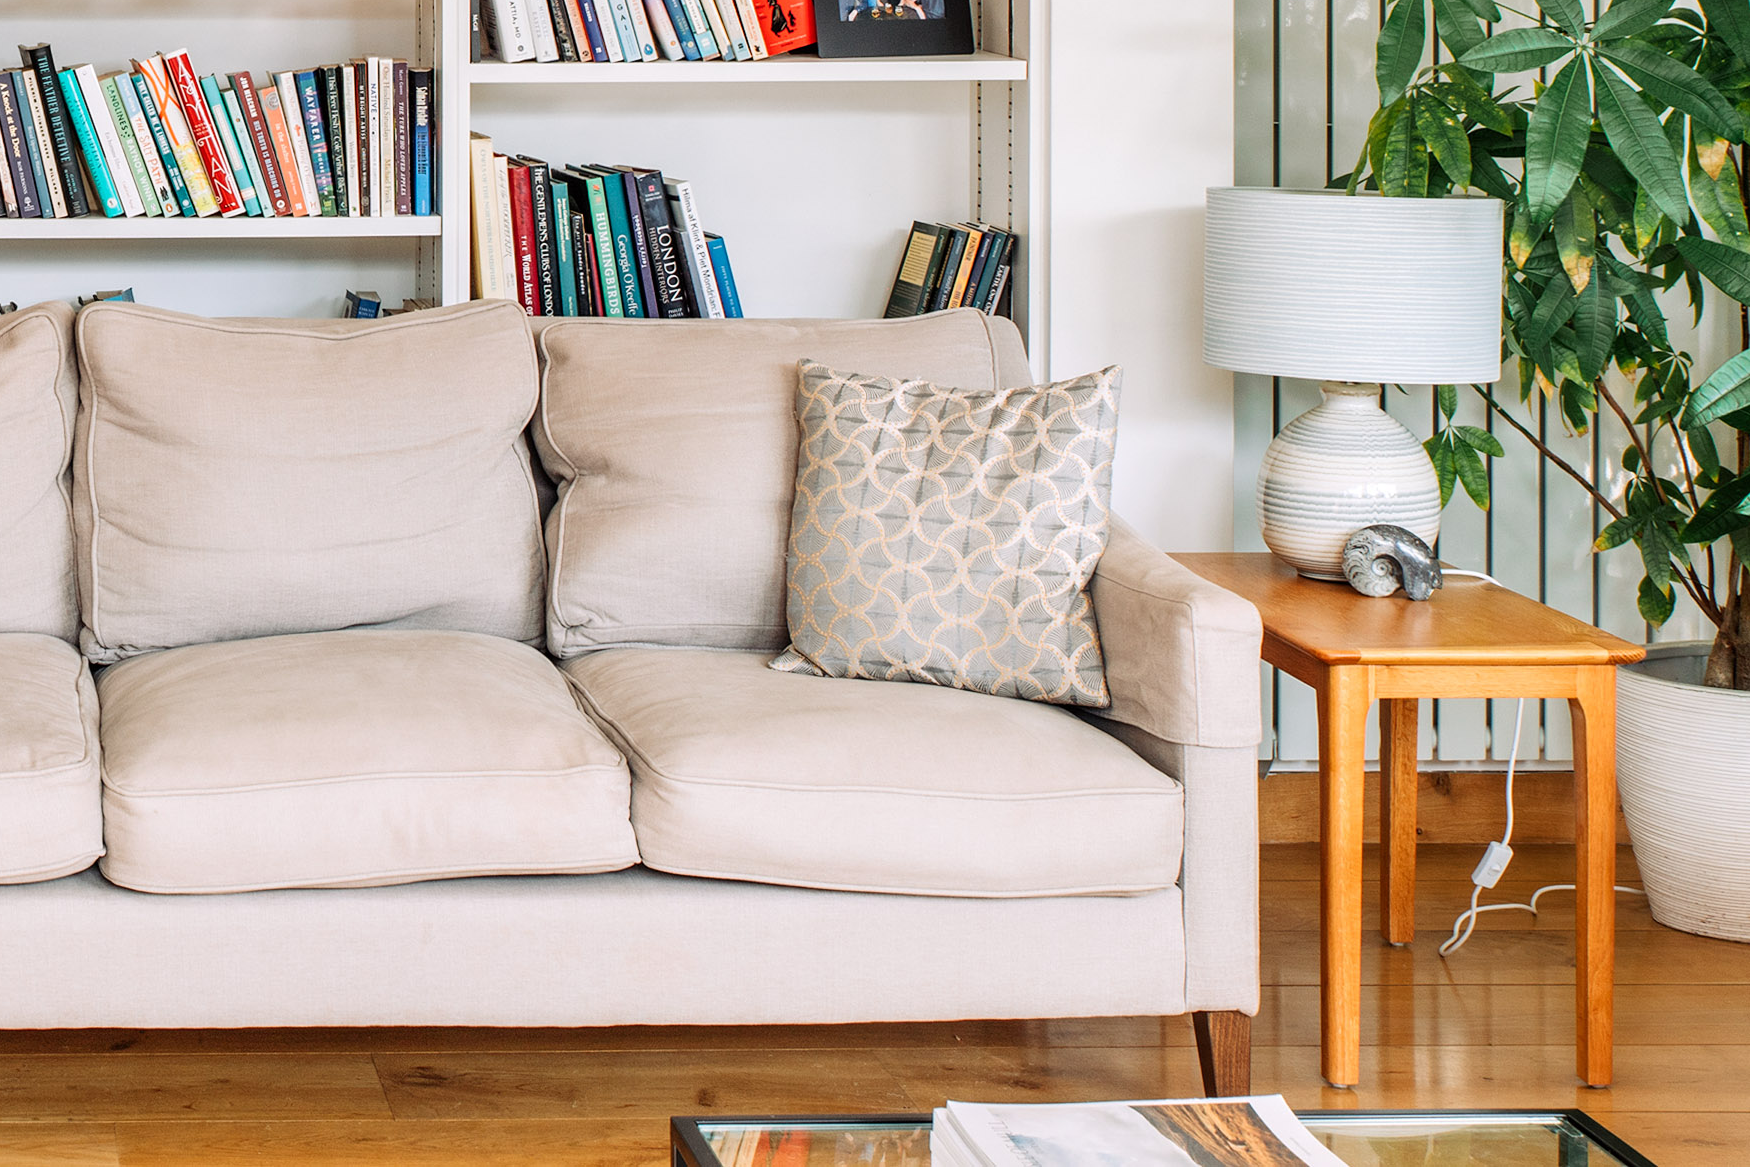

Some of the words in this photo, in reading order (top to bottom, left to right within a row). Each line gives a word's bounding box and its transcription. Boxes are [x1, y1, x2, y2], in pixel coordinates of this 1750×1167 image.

[37, 55, 50, 73] THE
[41, 74, 58, 114] FEATHER
[107, 84, 128, 132] LANDLINES
[305, 86, 321, 140] WAYFARER
[50, 115, 70, 163] DETECTIVE
[125, 138, 143, 175] RAYNOR
[139, 175, 154, 202] WINN
[535, 168, 546, 184] THE
[536, 185, 549, 242] GENTLEMEN'S
[682, 188, 693, 213] Hilma
[687, 213, 696, 222] af
[691, 223, 702, 242] Klint
[541, 243, 553, 270] CLUBS
[596, 212, 619, 315] HUMMINGBIRDS
[618, 234, 631, 272] Georgia
[649, 227, 660, 260] HIDDEN
[655, 262, 669, 304] INTERIORS
[657, 224, 683, 302] LONDON
[698, 251, 708, 269] Piet
[543, 272, 552, 284] OF
[624, 274, 639, 316] O'Keeffe
[701, 270, 718, 312] Mondrian:
[544, 285, 555, 316] LONDO
